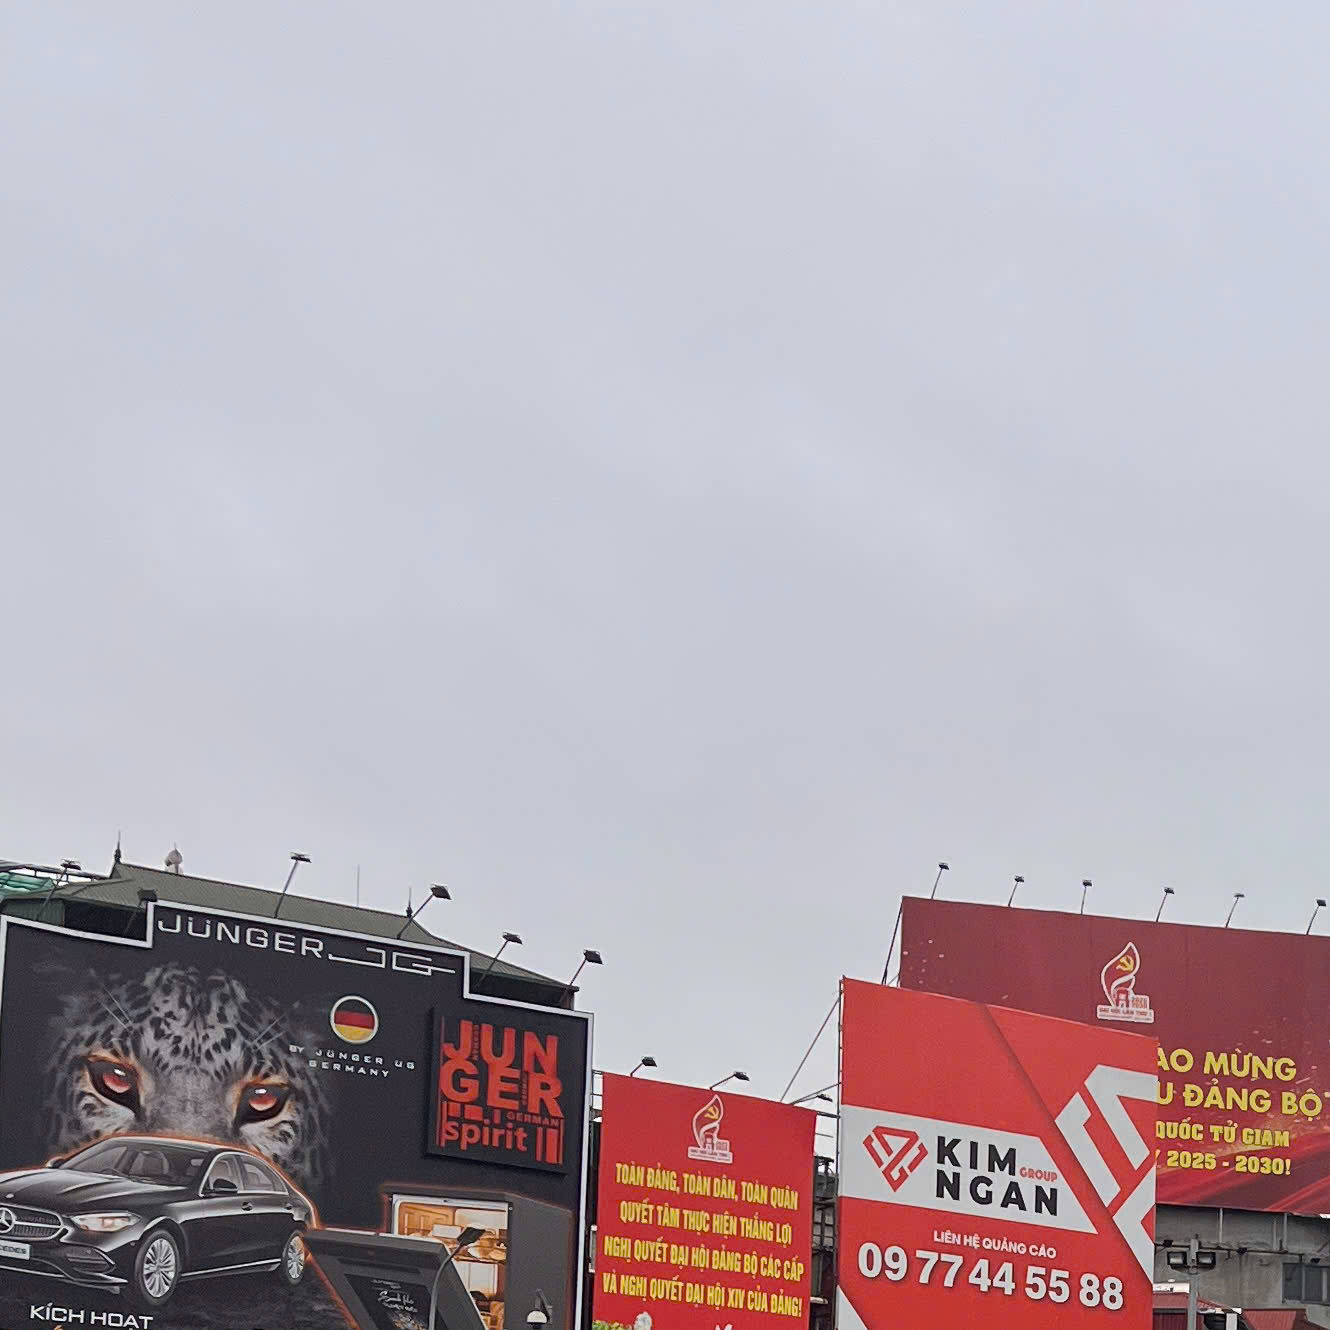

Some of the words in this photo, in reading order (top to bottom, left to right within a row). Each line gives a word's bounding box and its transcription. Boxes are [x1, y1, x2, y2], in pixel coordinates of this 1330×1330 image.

[157, 913, 324, 959] JÜNGER
[308, 1060, 389, 1078] GERMANY
[441, 1019, 559, 1076] JUN
[1203, 1047, 1297, 1082] MỪNG
[439, 1058, 565, 1119] GER
[1183, 1077, 1272, 1113] ĐẢNG
[1281, 1087, 1323, 1122] BỘ
[444, 1120, 528, 1152] spirit
[1209, 1119, 1238, 1143] TỬ
[936, 1134, 1016, 1177] KIM
[1019, 1166, 1058, 1183] GROUP
[1167, 1150, 1217, 1170] 2025
[1235, 1155, 1292, 1176] 2030!
[615, 1161, 644, 1186] TOÀN
[683, 1171, 711, 1197] TOÀN
[935, 1168, 1059, 1217] NGAN
[620, 1197, 654, 1224] QUYẾT
[656, 1203, 680, 1229] TÂM
[683, 1209, 710, 1236] THỰC
[712, 1210, 737, 1239] HIỆN
[775, 1222, 792, 1248] LỢI
[933, 1228, 961, 1247] LIÊN
[963, 1232, 981, 1250] HỆ
[982, 1235, 1027, 1255] QUẢNG
[1029, 1241, 1057, 1260] CÁO
[604, 1235, 632, 1263] NGHỊ
[634, 1236, 668, 1264] QUYẾT
[669, 1245, 689, 1269] ĐẠI
[691, 1244, 710, 1272] HỘI
[711, 1244, 741, 1272] ĐẢNG
[743, 1250, 758, 1279] BỘ
[760, 1253, 781, 1279] CÁC
[783, 1255, 805, 1282] CẤP
[857, 1241, 909, 1282] 09
[1024, 1264, 1071, 1304] 55
[1078, 1271, 1125, 1311] 88
[602, 1269, 617, 1294] VÀ
[620, 1274, 647, 1301] NGHỊ
[649, 1275, 684, 1302] QUYẾT
[686, 1282, 704, 1308] ĐẠI
[706, 1282, 725, 1310] HỘI
[727, 1287, 745, 1309] XIV
[747, 1285, 768, 1313] CỦA
[30, 1302, 84, 1324] KÍCH
